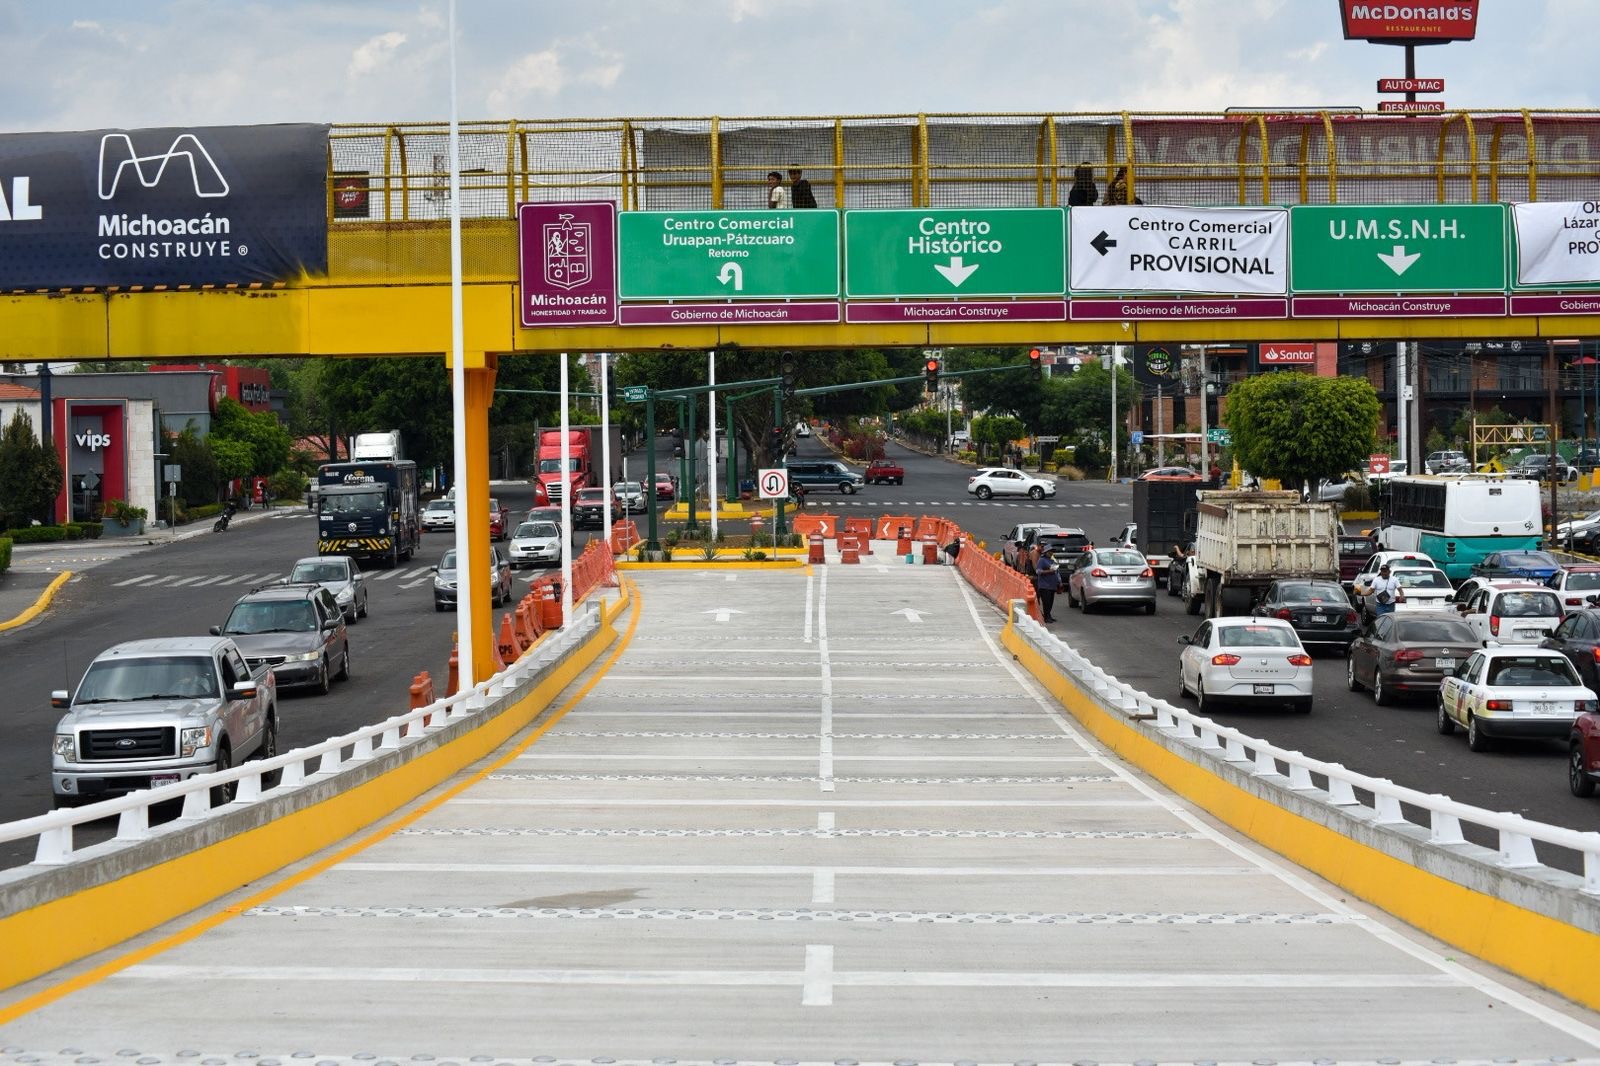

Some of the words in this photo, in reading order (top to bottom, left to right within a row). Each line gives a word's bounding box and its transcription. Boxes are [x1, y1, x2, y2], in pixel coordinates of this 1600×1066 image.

[1351, 5, 1472, 20] McDonald's
[0, 176, 42, 220] L
[98, 212, 230, 236] Michoacán
[664, 218, 715, 230] Centro
[719, 217, 794, 229] Comercial
[919, 217, 991, 235] Centro
[1128, 217, 1185, 232] Centro
[1189, 219, 1272, 235] Comercial
[1329, 219, 1466, 240] U.M.S.N.H.
[663, 233, 795, 248] Uruapan-Pátzcuaro
[908, 236, 1002, 254] Histórico
[1169, 236, 1237, 251] CARRIL
[1569, 241, 1600, 254] PRO
[98, 241, 231, 259] CONSTRUYE
[708, 248, 749, 258] Retorno
[1130, 254, 1274, 275] PROVISIONAL
[531, 293, 607, 306] Michoacán
[1348, 301, 1401, 311] Michoacán
[1402, 300, 1451, 312] Construye
[671, 310, 718, 319] Gobierno
[720, 309, 733, 318] de
[735, 308, 788, 318] Michoacán
[903, 306, 957, 316] Michoacán
[958, 306, 1009, 317] Construye
[1121, 305, 1168, 316] Gobierno
[1169, 305, 1182, 315] de
[1184, 304, 1237, 315] Michoacán
[75, 429, 111, 451] vips
